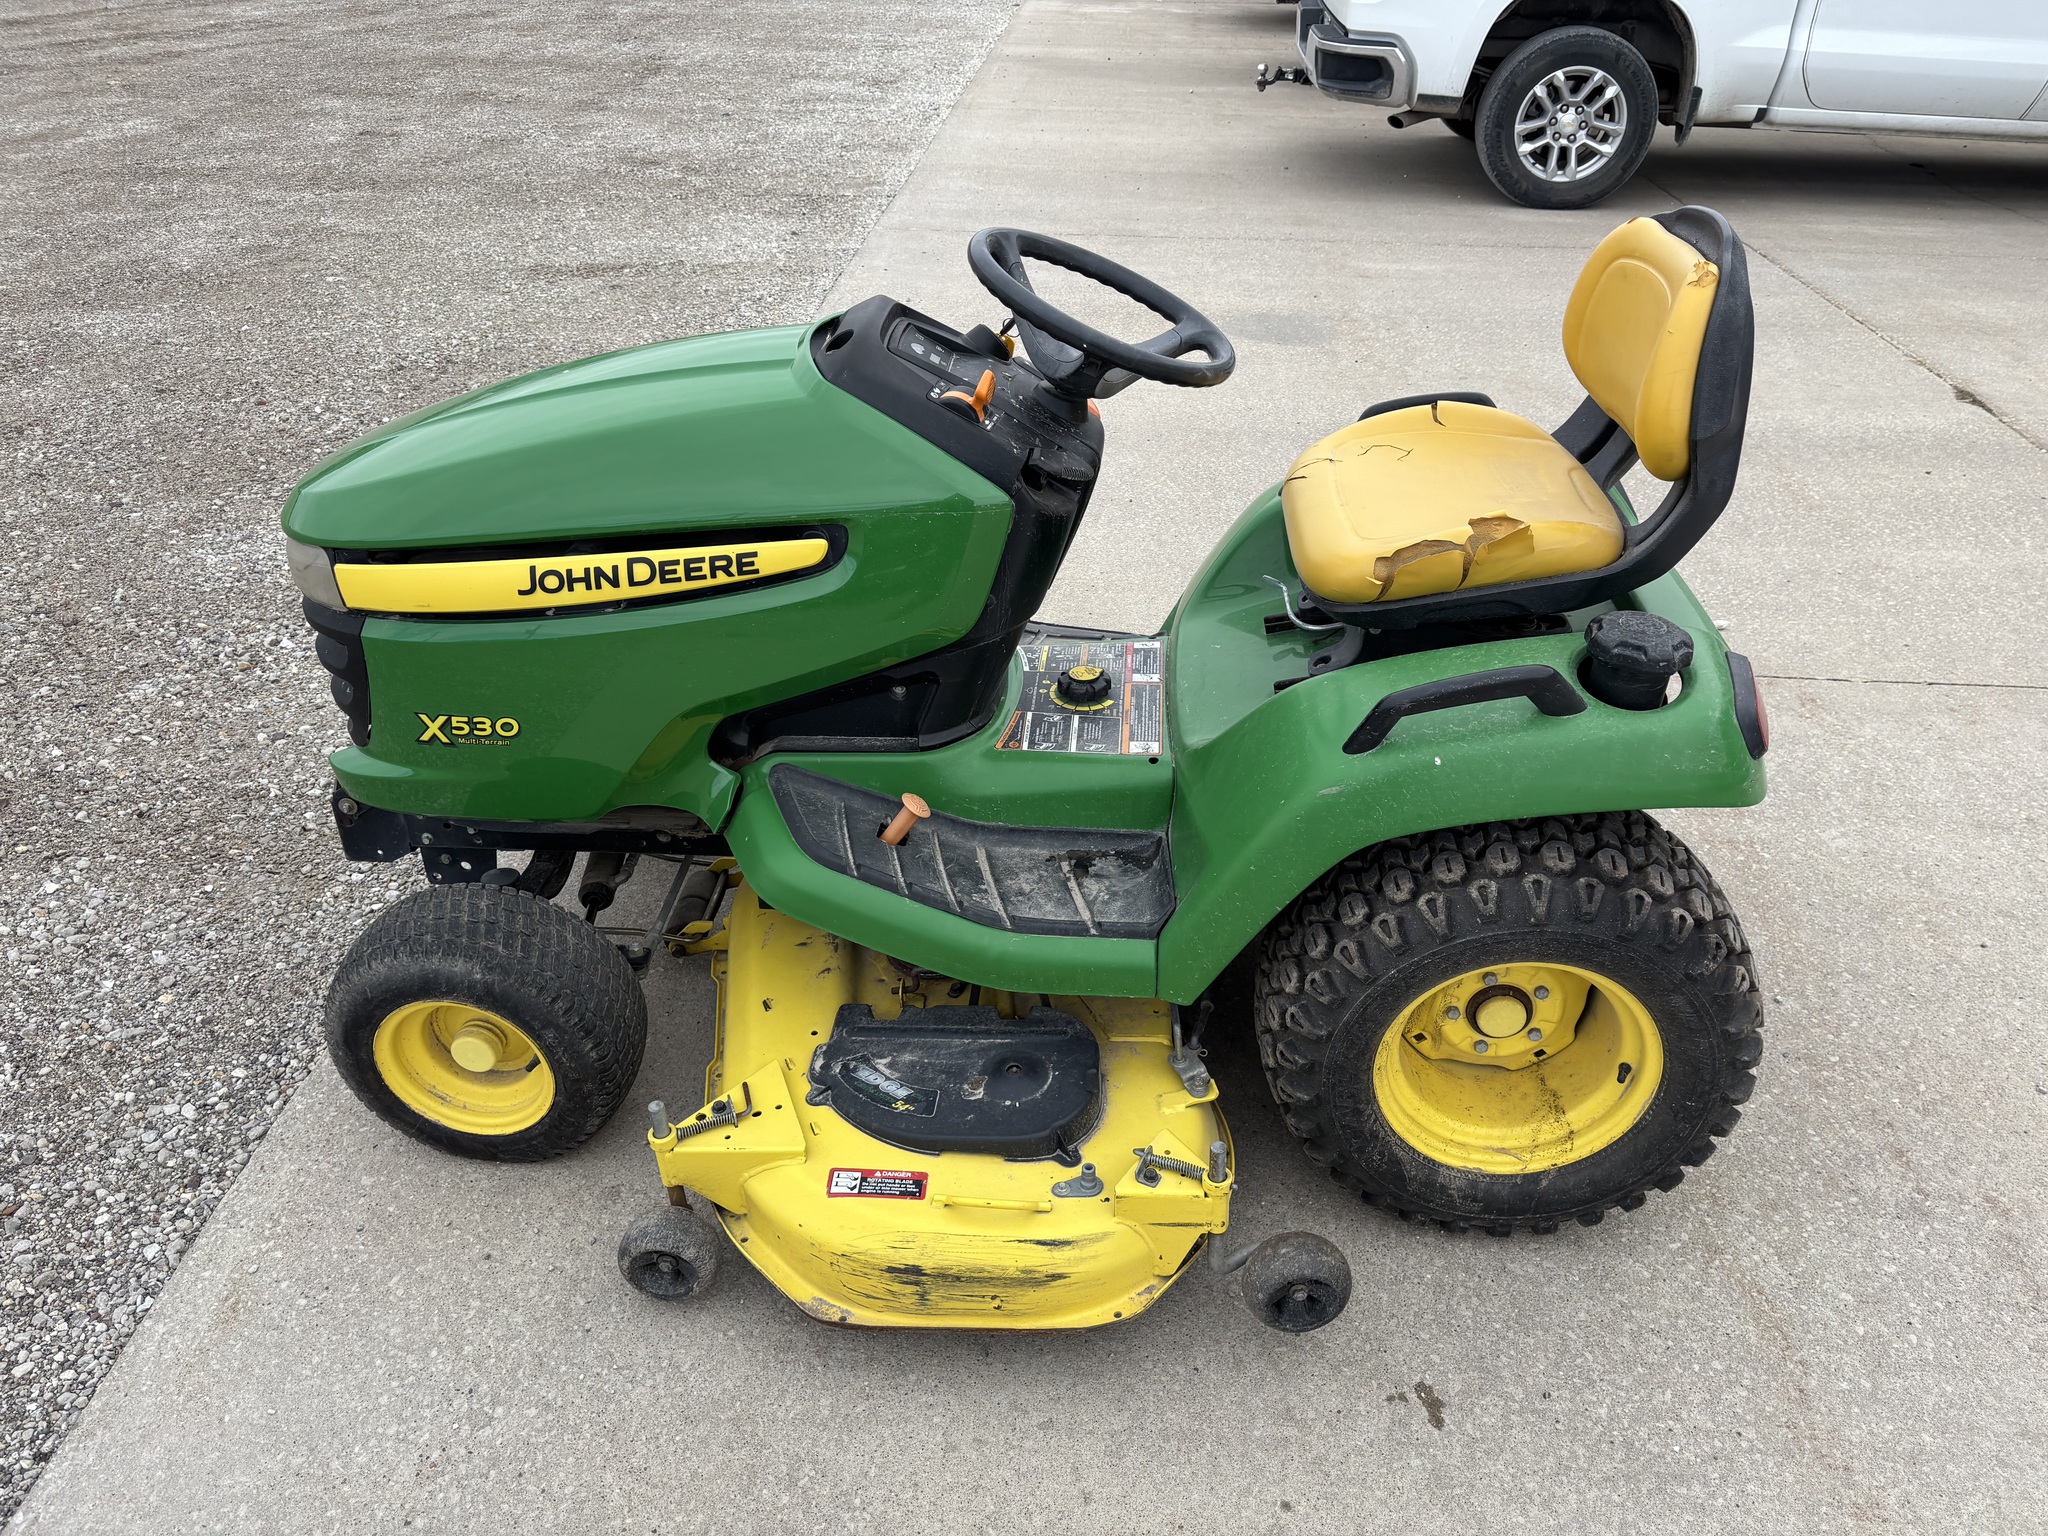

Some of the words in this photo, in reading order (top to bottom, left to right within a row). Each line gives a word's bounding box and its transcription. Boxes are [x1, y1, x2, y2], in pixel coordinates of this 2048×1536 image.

[517, 564, 620, 597] JOHN
[627, 551, 760, 588] DEERE
[413, 711, 521, 748] X530
[458, 737, 511, 746] Multi-Terrain
[850, 1066, 915, 1100] EDGE
